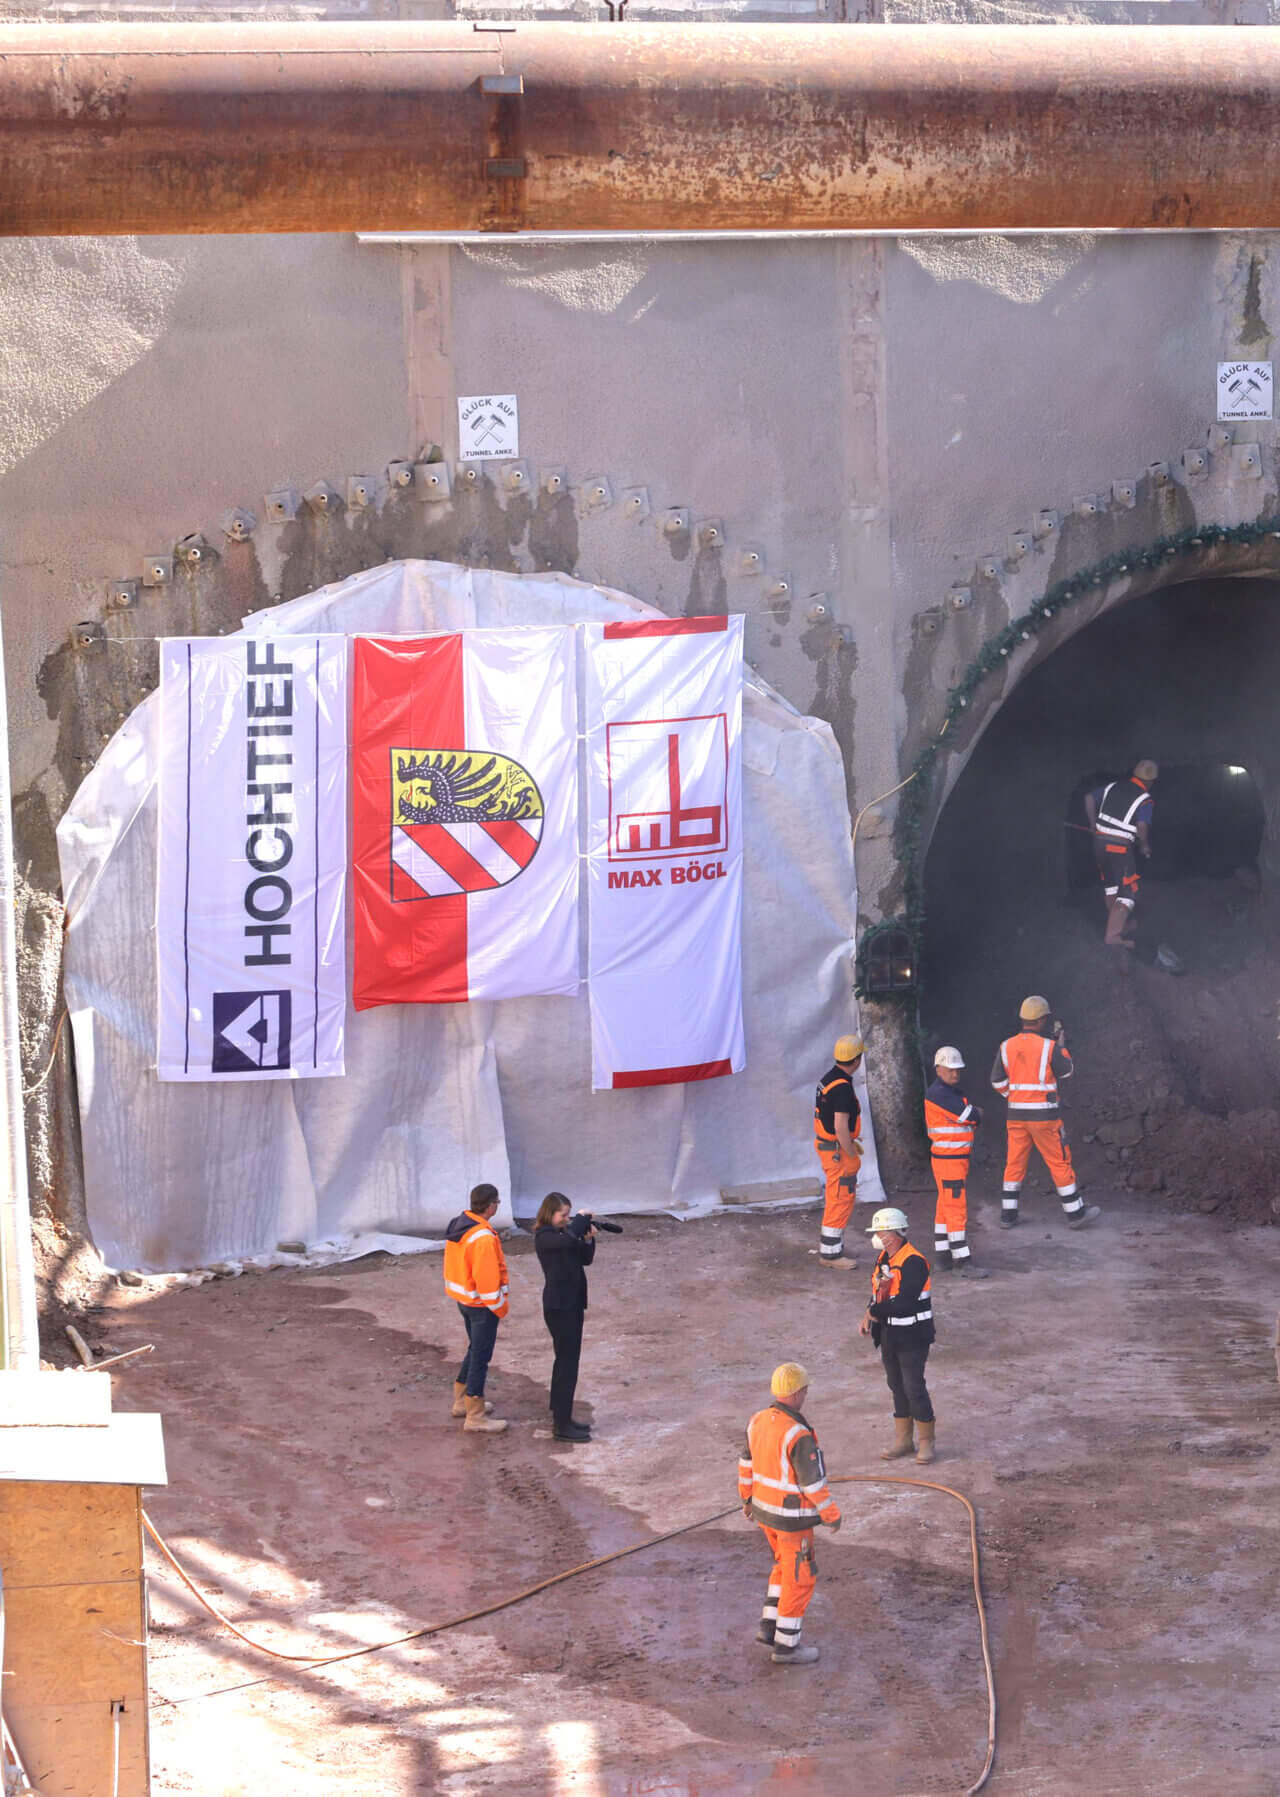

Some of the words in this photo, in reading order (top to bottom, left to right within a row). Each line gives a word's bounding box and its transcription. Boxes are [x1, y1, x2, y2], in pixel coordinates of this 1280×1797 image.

[1253, 367, 1271, 382] AUF
[496, 402, 515, 417] AUF
[244, 640, 293, 967] HOCHTIEF
[608, 868, 662, 889] MAX
[670, 860, 727, 885] BÖGL
